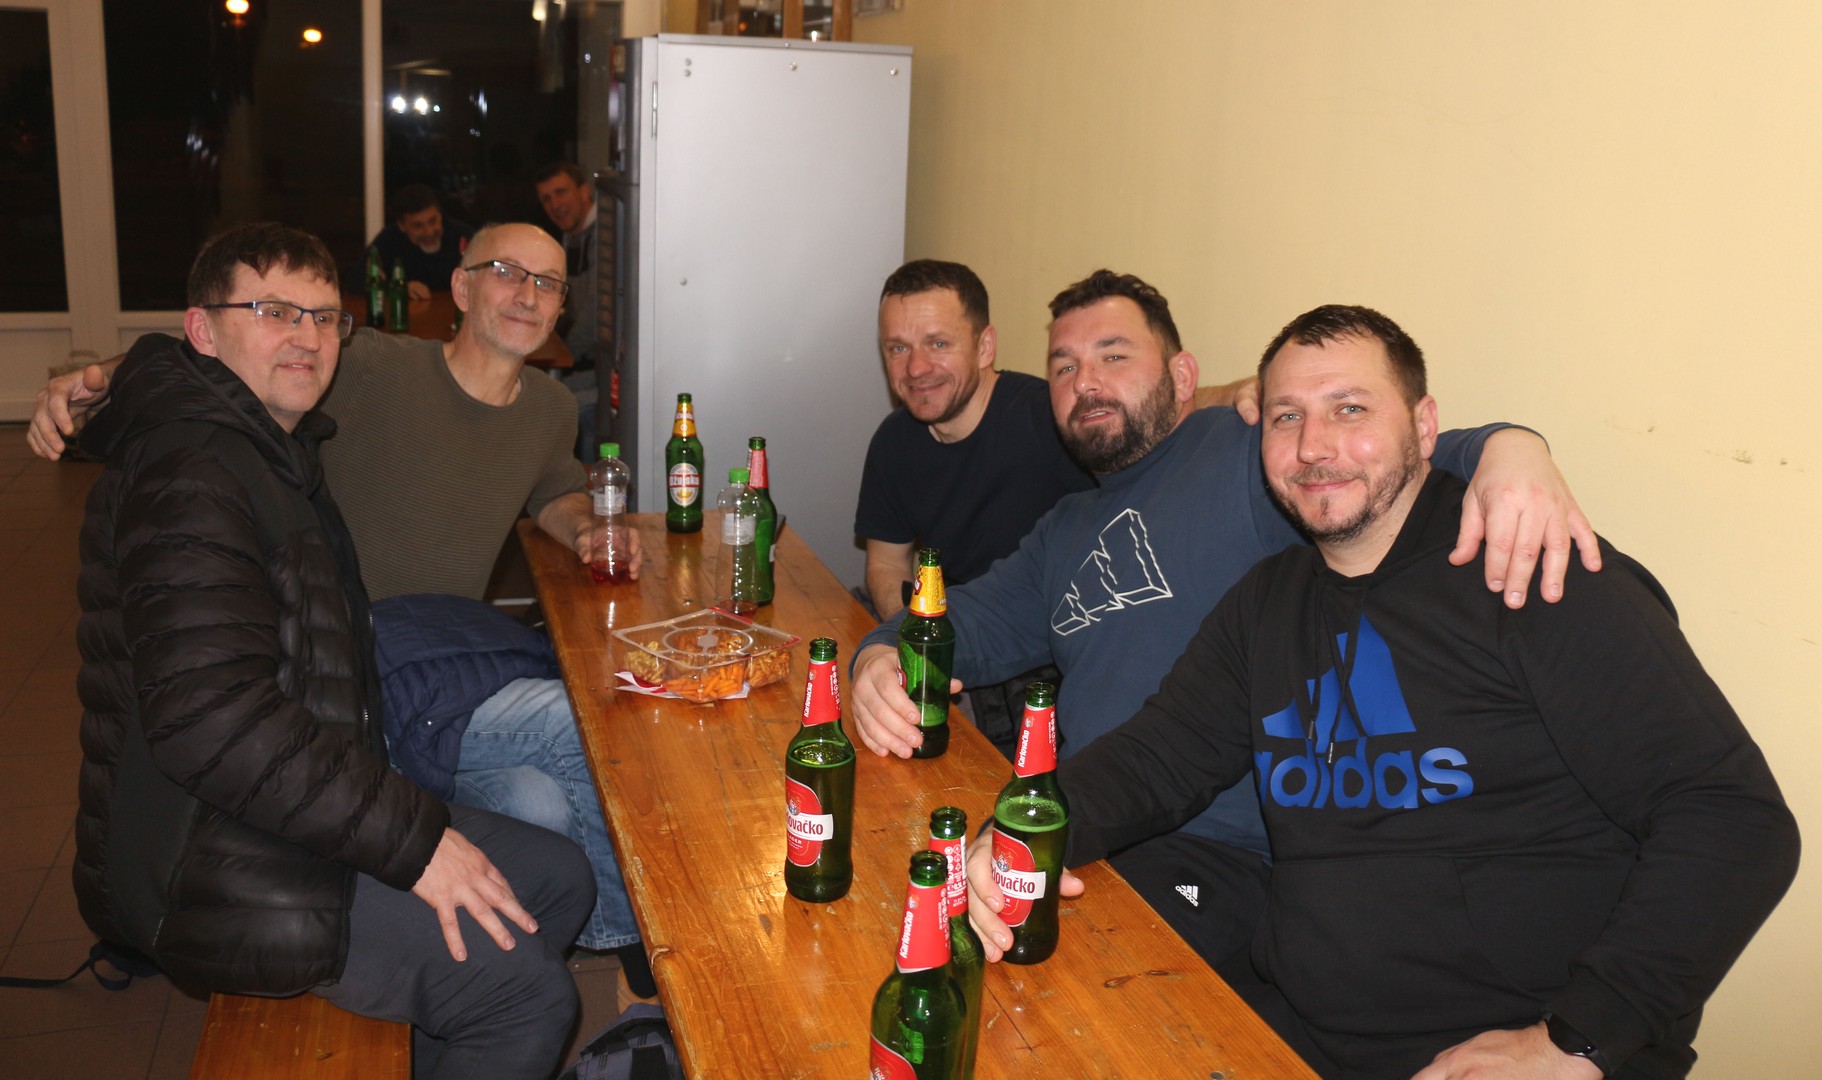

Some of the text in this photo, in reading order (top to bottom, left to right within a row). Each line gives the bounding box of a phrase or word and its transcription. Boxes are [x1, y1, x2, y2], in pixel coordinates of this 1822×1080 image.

[1017, 729, 1030, 768] Karlovačko
[787, 815, 824, 835] ovačko
[899, 910, 914, 959] Karlovačko
